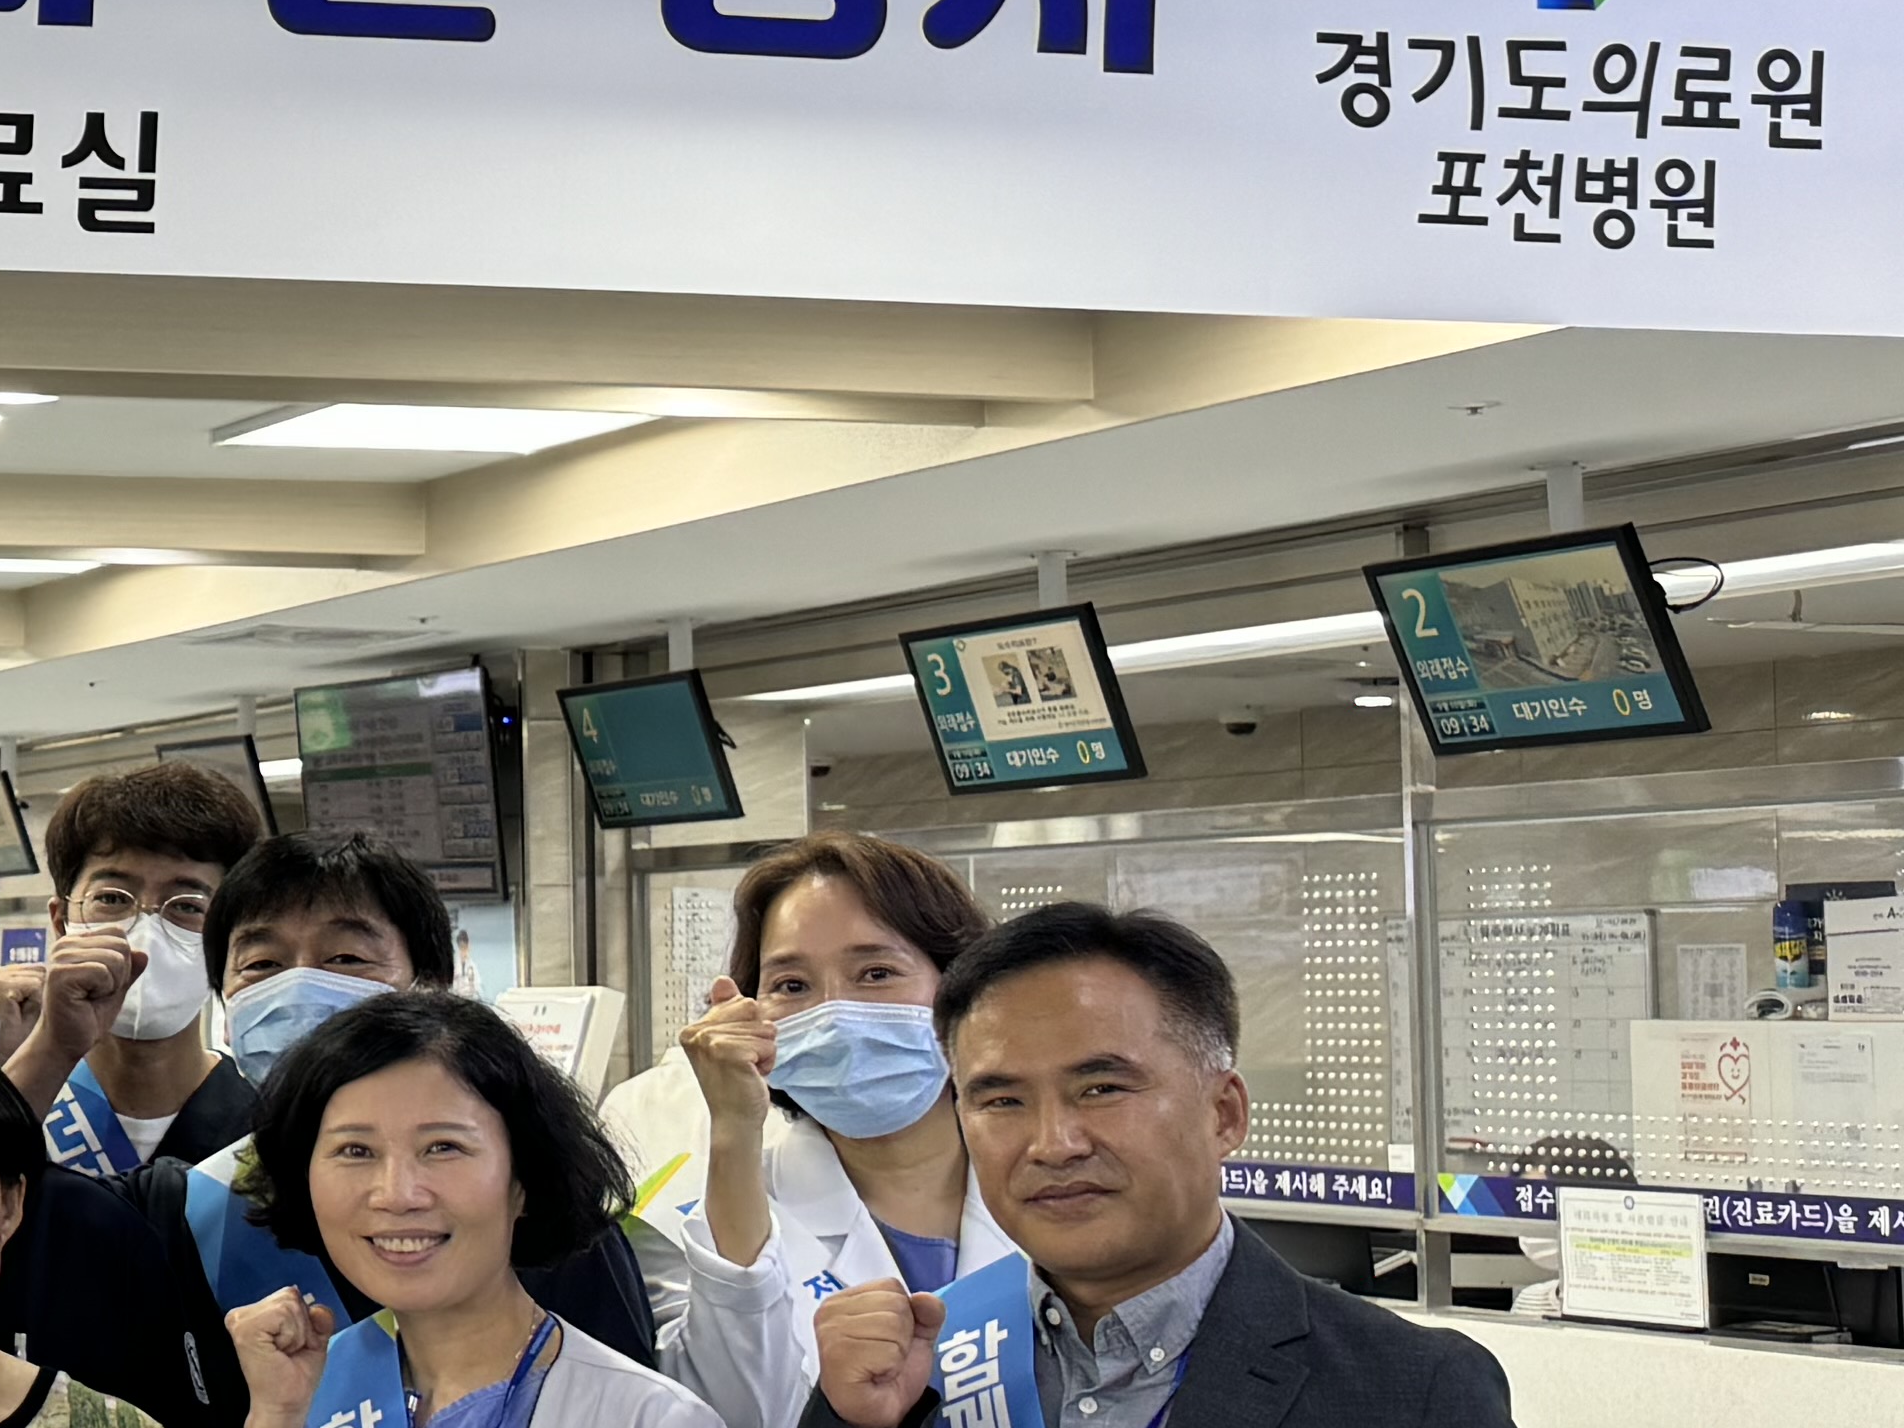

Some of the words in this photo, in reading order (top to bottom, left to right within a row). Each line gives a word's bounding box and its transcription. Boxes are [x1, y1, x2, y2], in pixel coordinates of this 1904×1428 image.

[1313, 28, 1826, 151] 경기도의료원
[1417, 149, 1718, 251] 포천병원
[1401, 588, 1440, 638] 2
[927, 653, 952, 696] 3
[1416, 655, 1470, 682] 외래접수
[1511, 696, 1588, 721] 대기인수
[1612, 688, 1631, 716] 0
[1632, 689, 1653, 711] 명
[582, 707, 598, 744] 4
[1005, 747, 1060, 767] 대기인수
[1076, 740, 1090, 764] 0
[1274, 1169, 1326, 1199] 제시해
[1332, 1173, 1393, 1205] 주세요!
[1515, 1185, 1556, 1214] 접수
